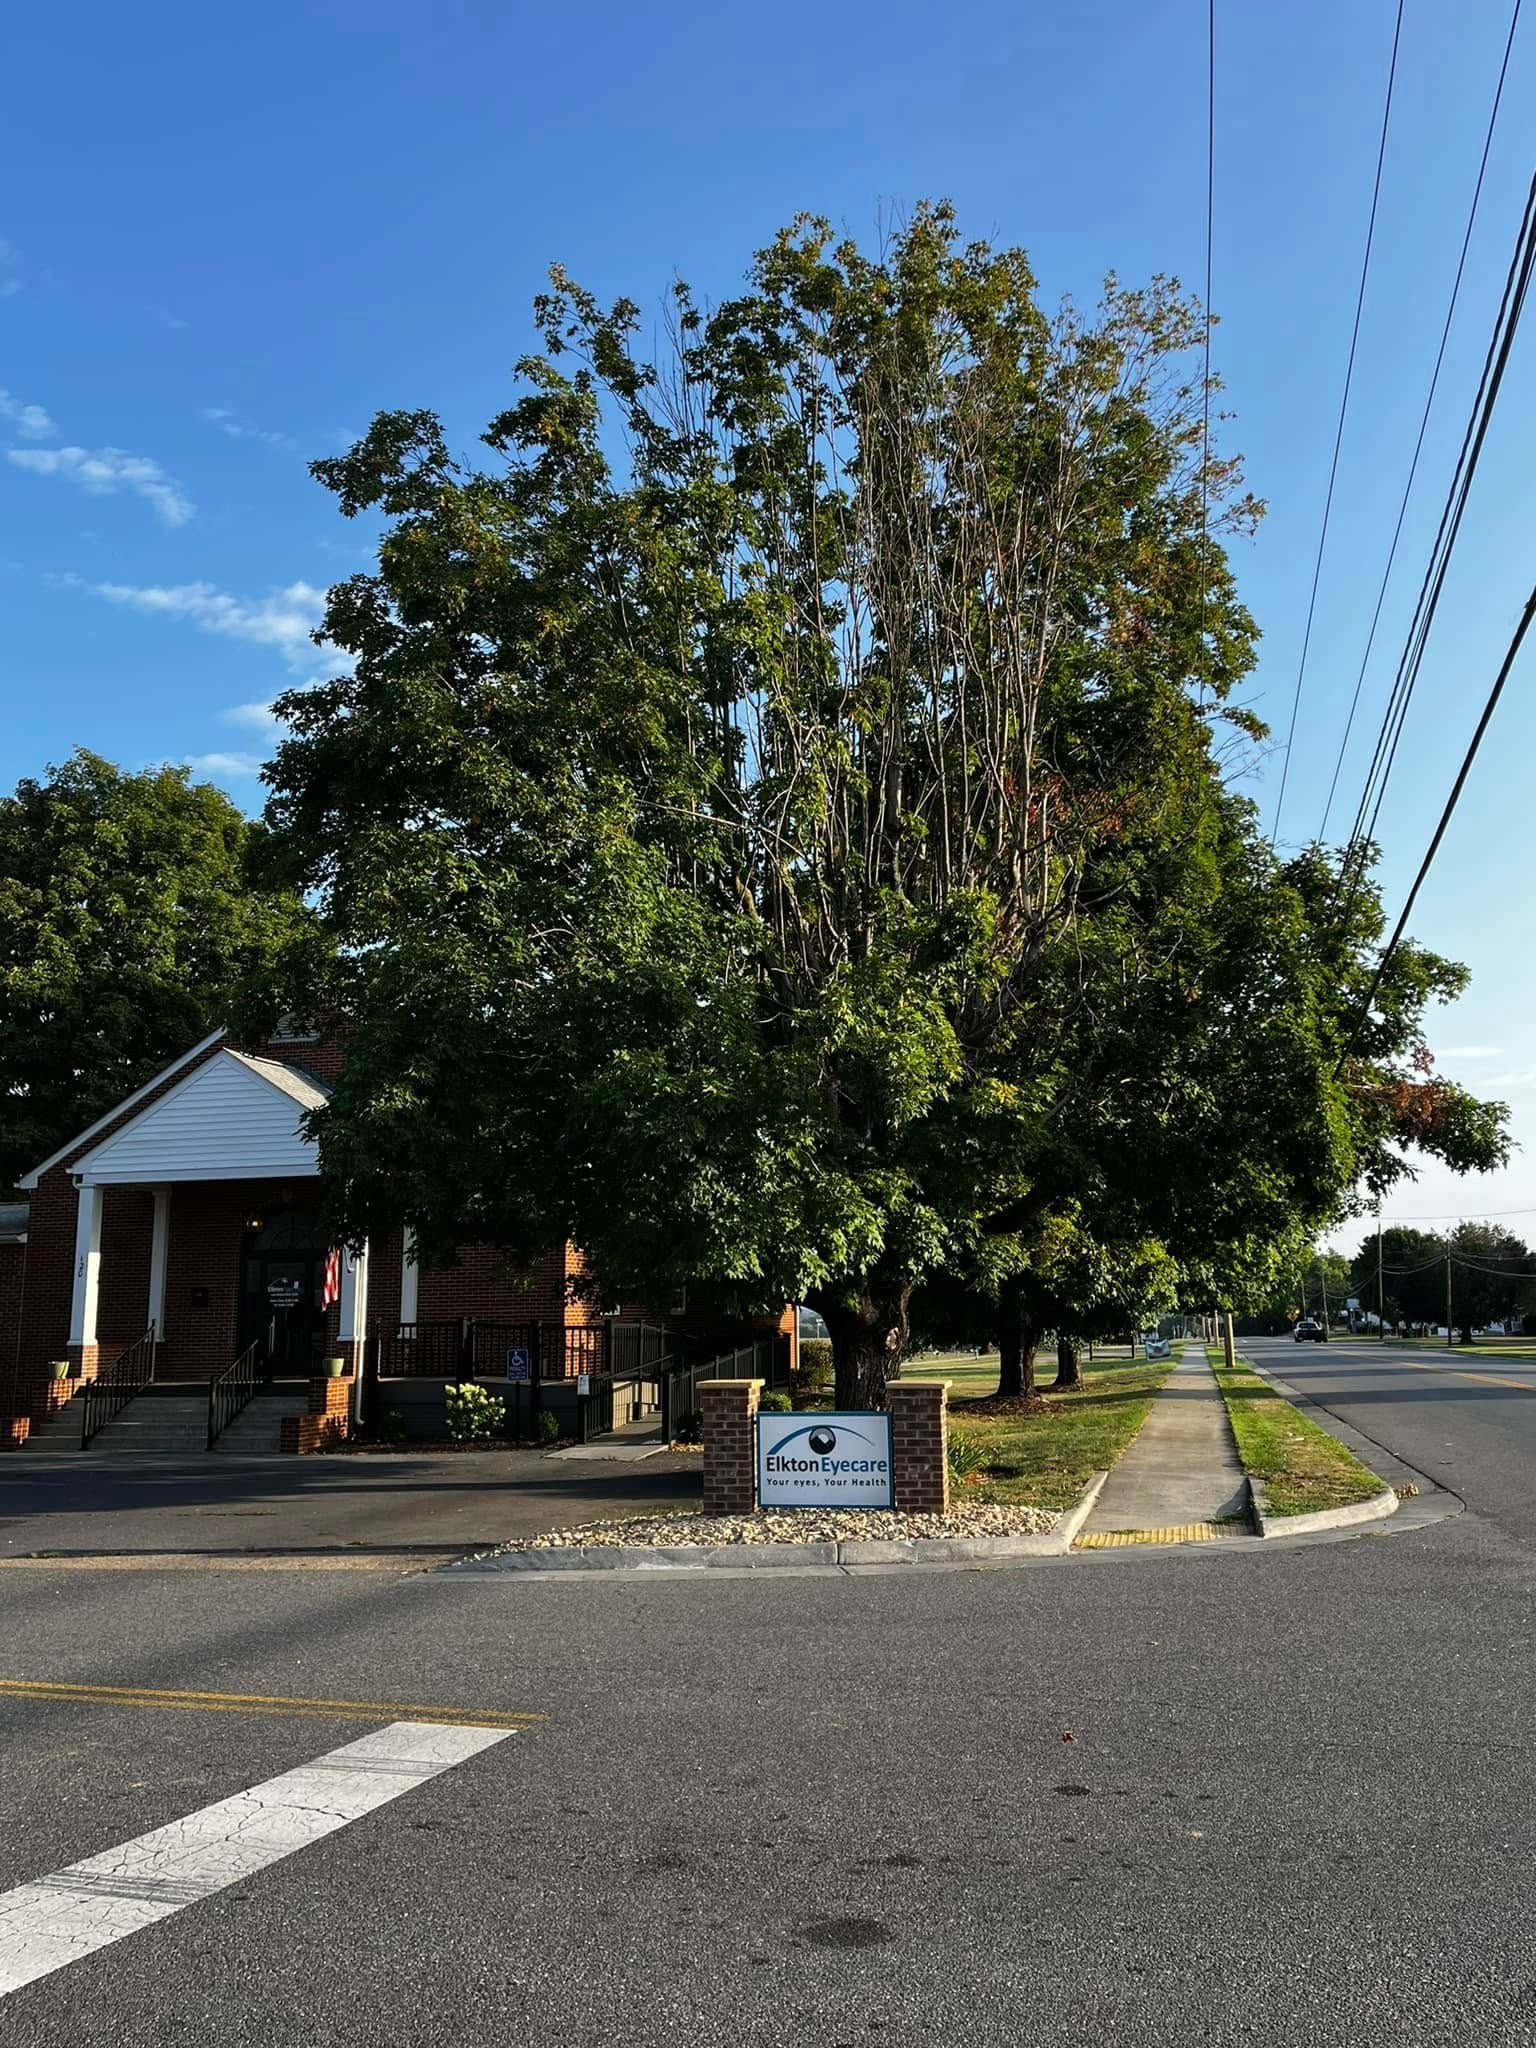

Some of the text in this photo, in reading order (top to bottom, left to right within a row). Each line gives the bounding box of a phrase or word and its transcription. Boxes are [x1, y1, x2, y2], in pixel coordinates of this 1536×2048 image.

[766, 1456, 887, 1475] Elkton Eyecare
[766, 1478, 887, 1488] Your eyes, Your Health
